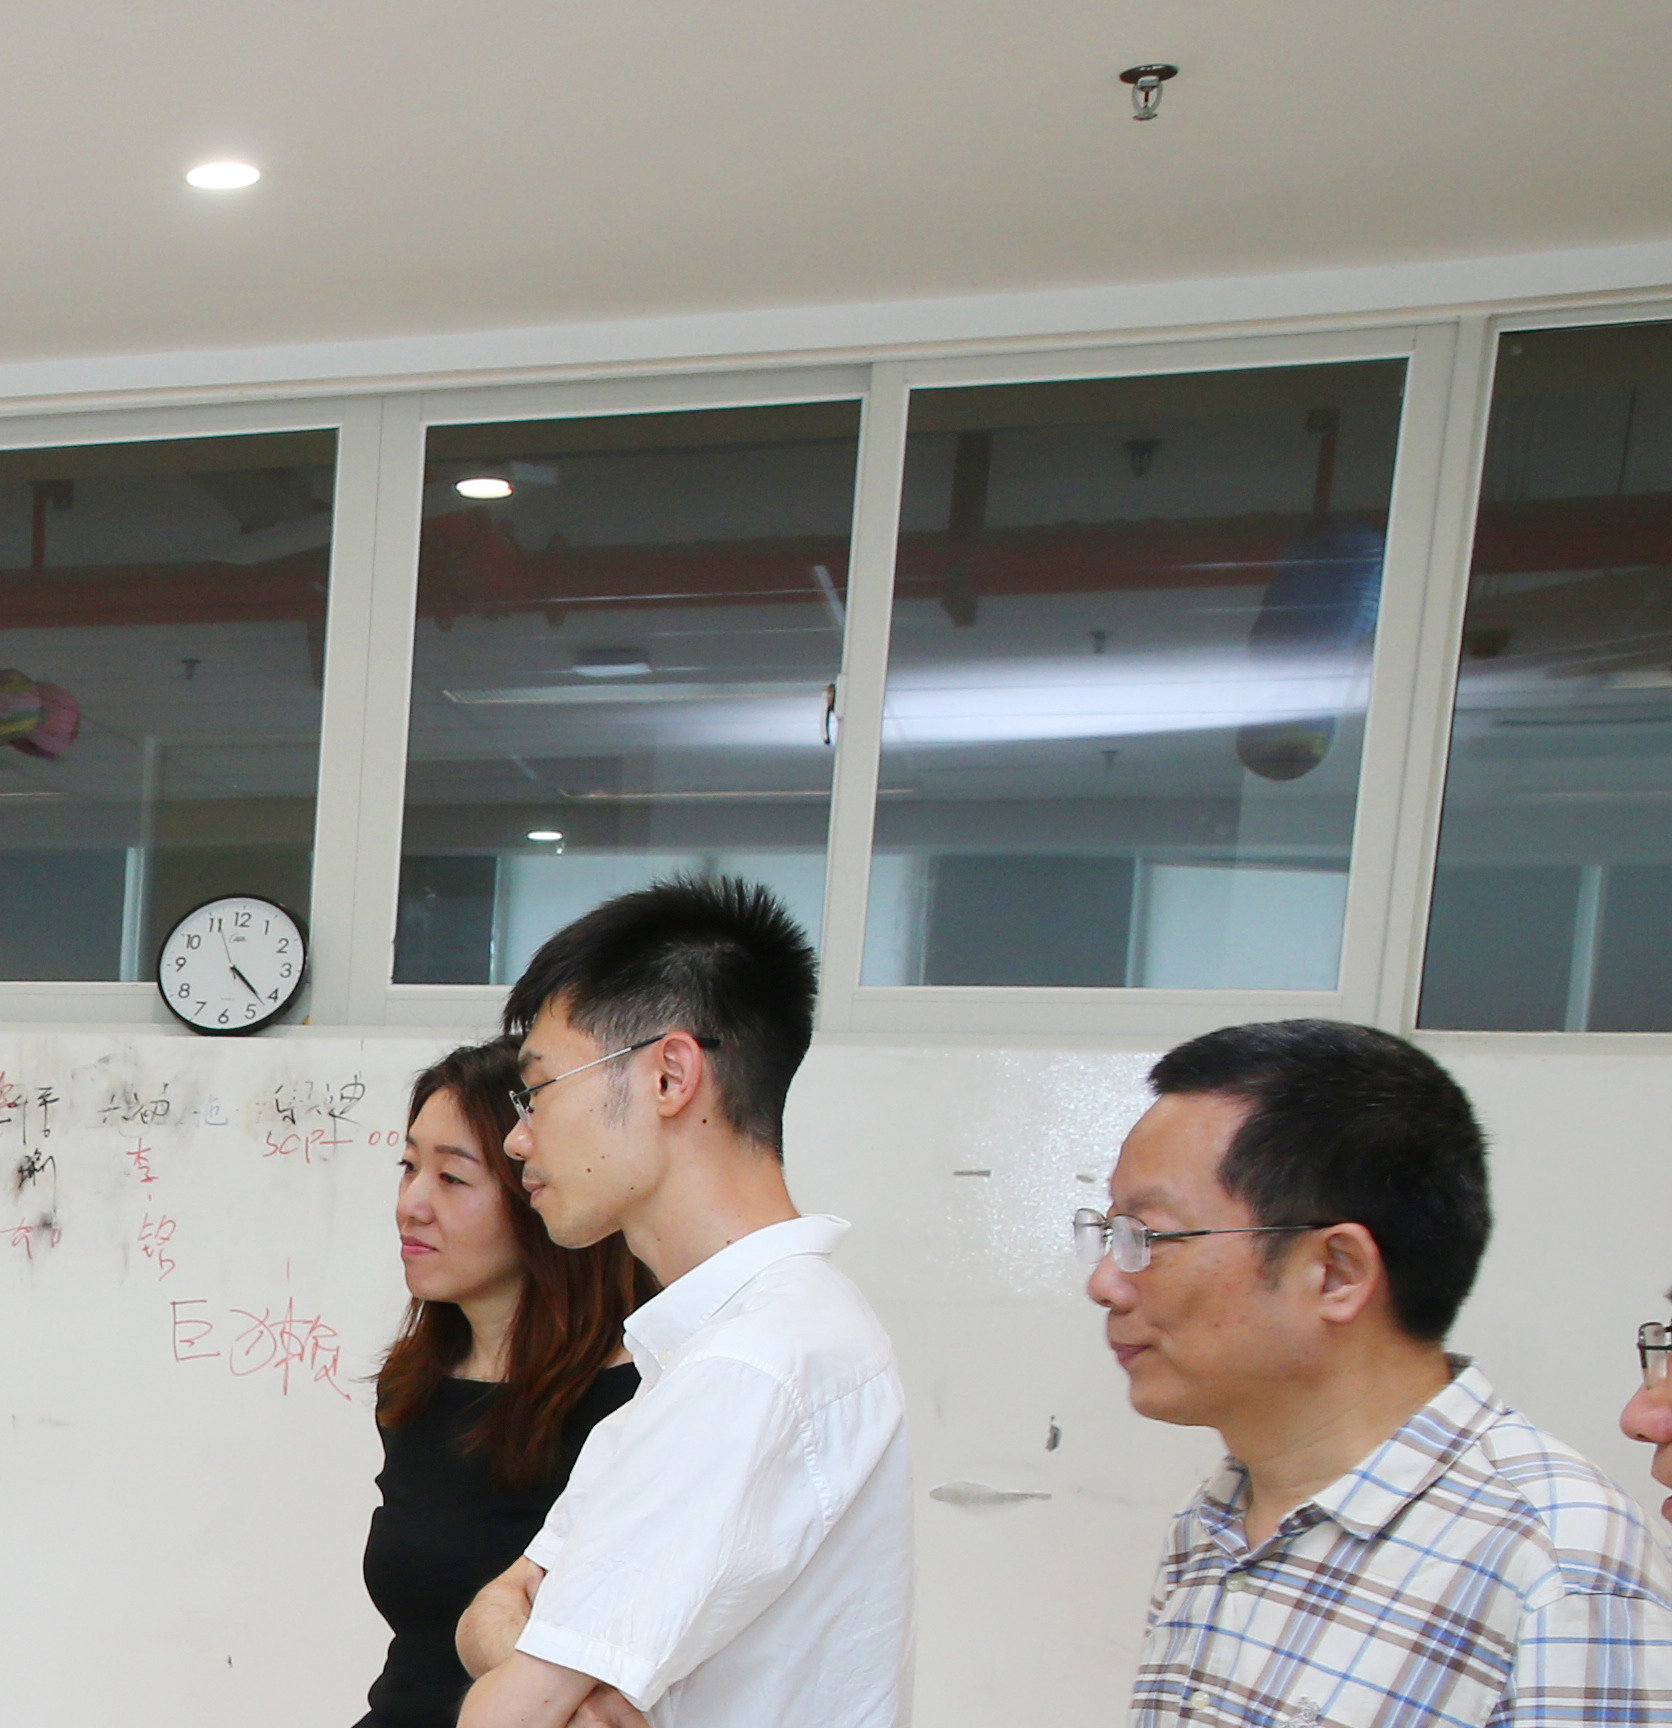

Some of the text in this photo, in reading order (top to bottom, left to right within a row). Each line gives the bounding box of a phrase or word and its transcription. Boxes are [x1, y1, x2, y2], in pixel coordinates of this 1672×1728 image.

[209, 918, 223, 933] 11
[234, 912, 252, 928] 12
[264, 920, 270, 935] 1
[186, 934, 202, 950] 10
[276, 938, 289, 954] 2
[175, 957, 187, 973] 9
[279, 963, 292, 978] 3
[178, 983, 191, 999] 8
[267, 987, 279, 1003] 4
[195, 1001, 208, 1016] 7
[217, 1008, 230, 1025] 6
[244, 1004, 257, 1020] 5
